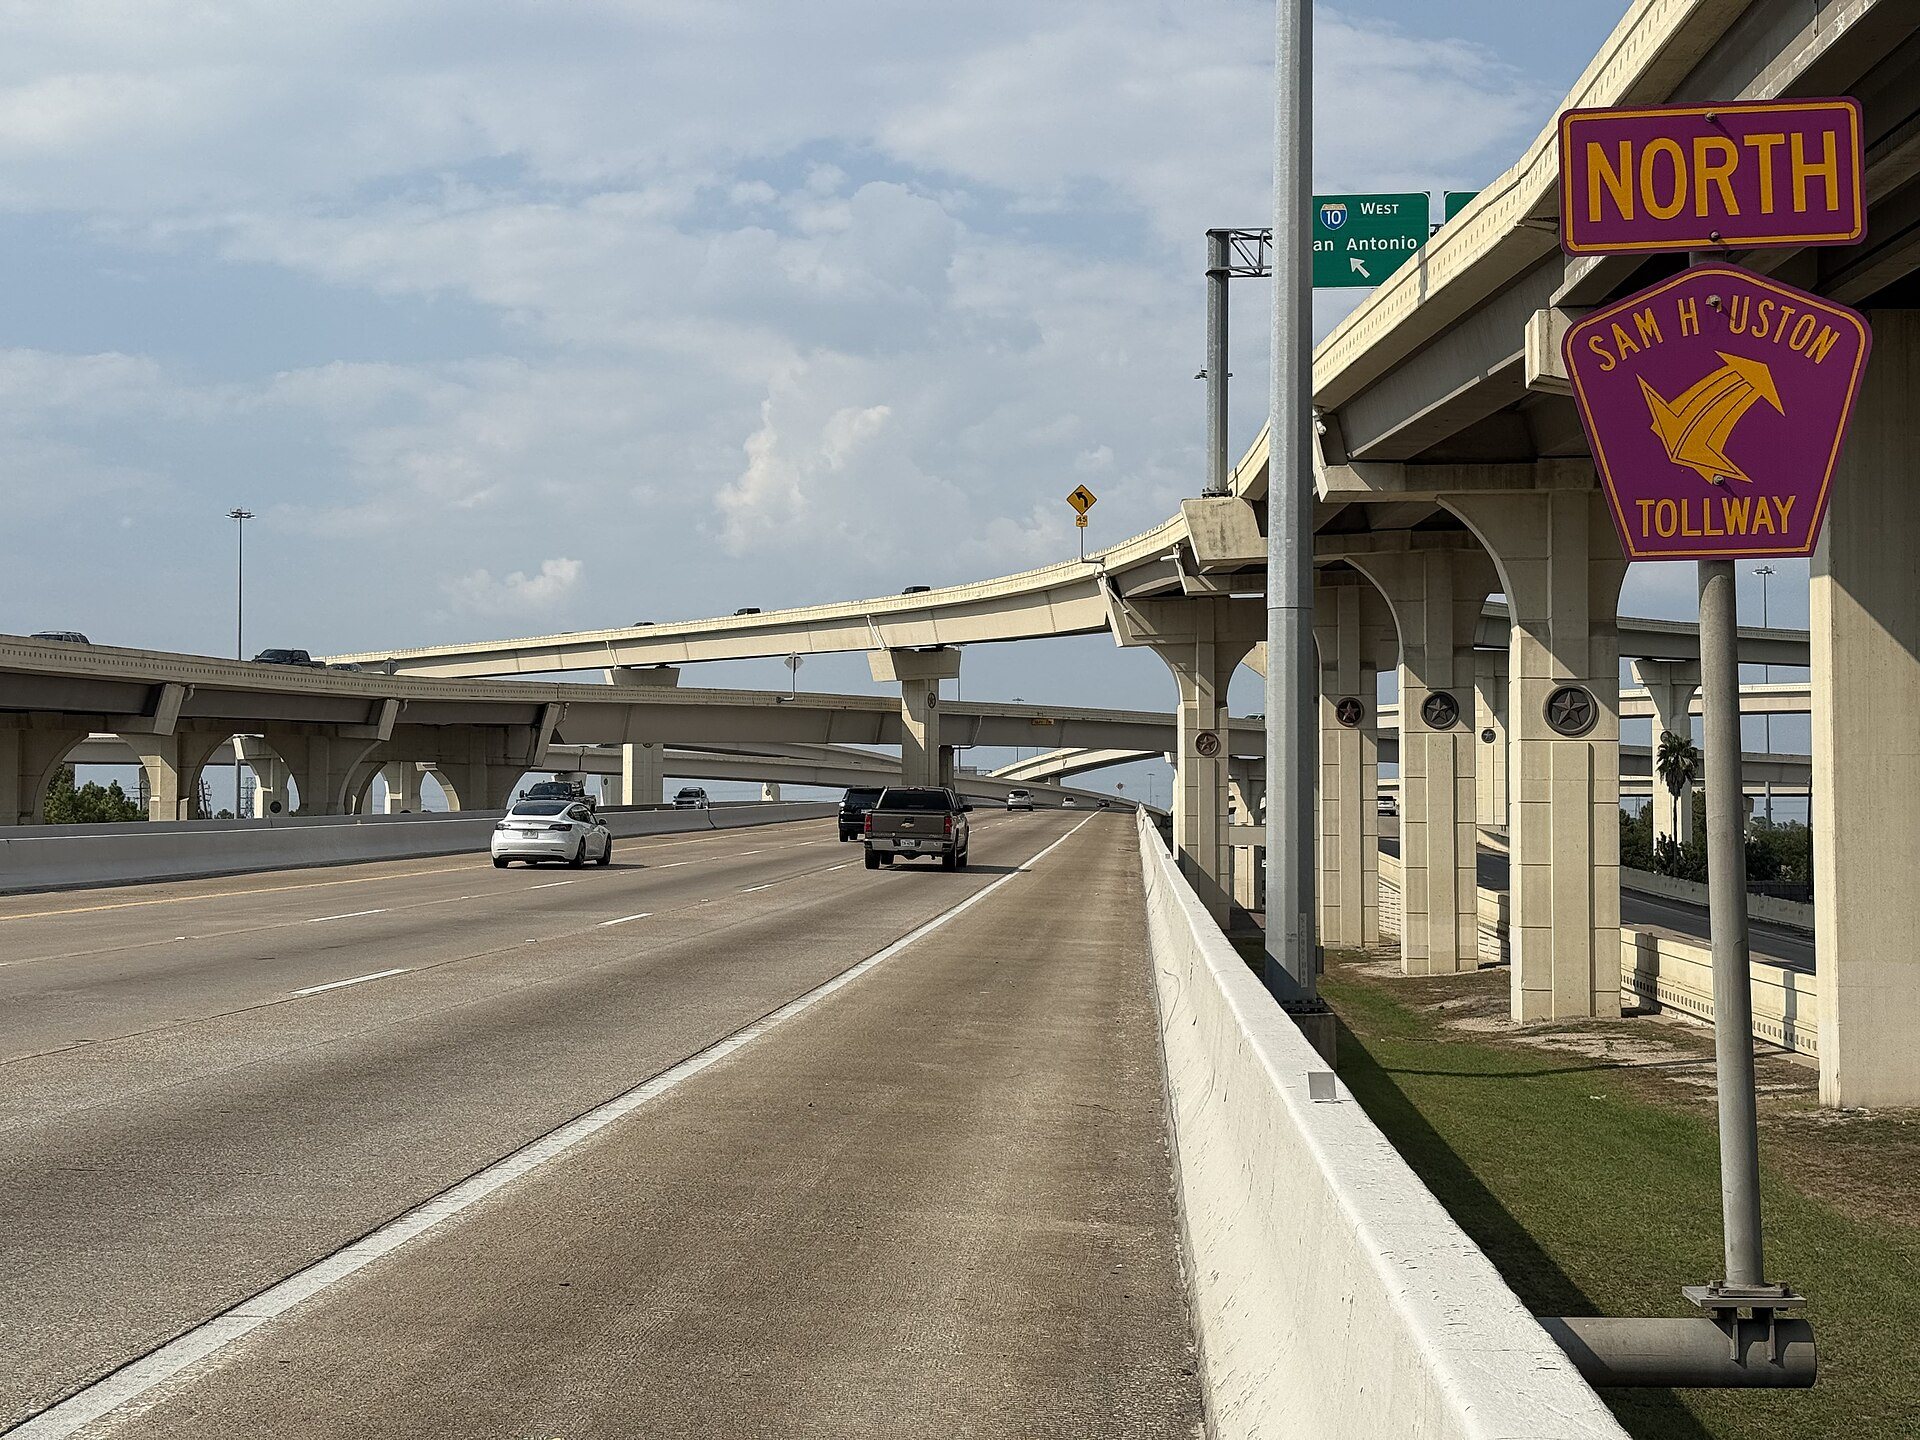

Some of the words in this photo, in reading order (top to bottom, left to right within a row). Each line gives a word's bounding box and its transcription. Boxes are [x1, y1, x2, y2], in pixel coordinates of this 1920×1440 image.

[1587, 131, 1839, 222] NORTH
[1326, 210, 1341, 225] 10
[1312, 240, 1334, 251] an
[1346, 235, 1417, 251] Antonio
[1588, 307, 1664, 371] SAM
[1677, 295, 1840, 364] HUSTON
[1635, 495, 1796, 537] TOLLWAY
